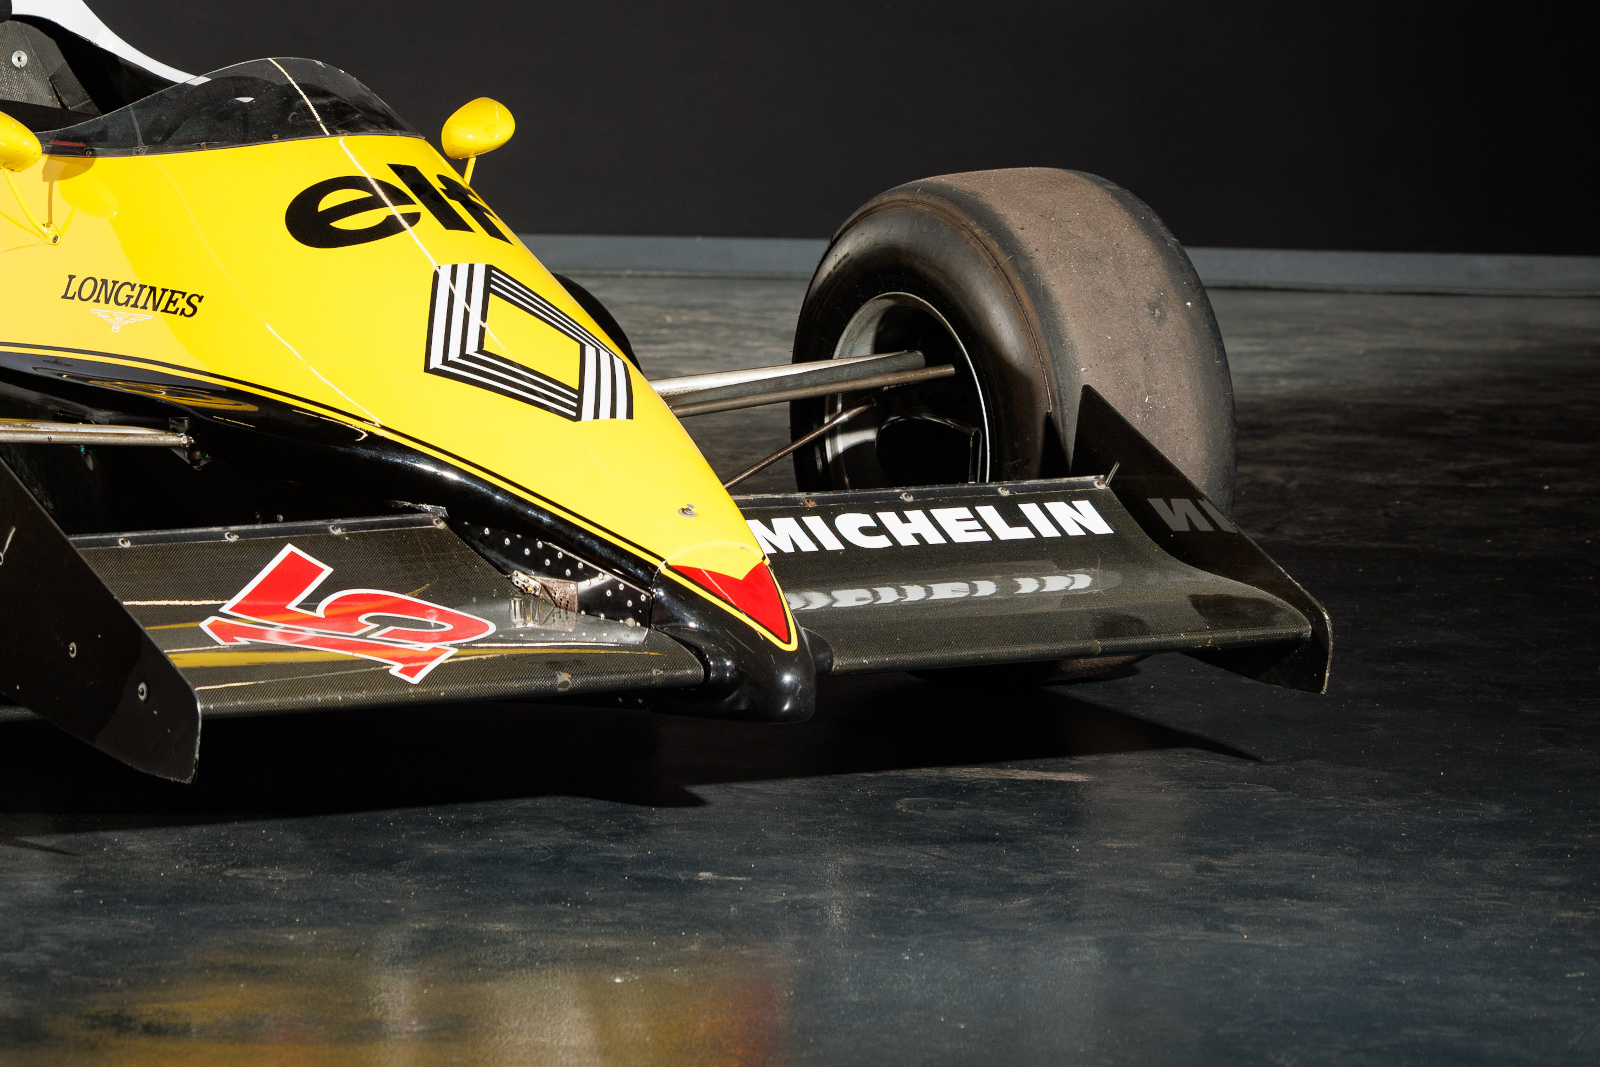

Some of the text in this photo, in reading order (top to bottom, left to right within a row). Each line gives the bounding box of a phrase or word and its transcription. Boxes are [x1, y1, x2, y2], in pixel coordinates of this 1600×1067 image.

[285, 163, 515, 249] elf
[61, 274, 204, 319] LONGINES
[745, 499, 1114, 554] MICHELIN
